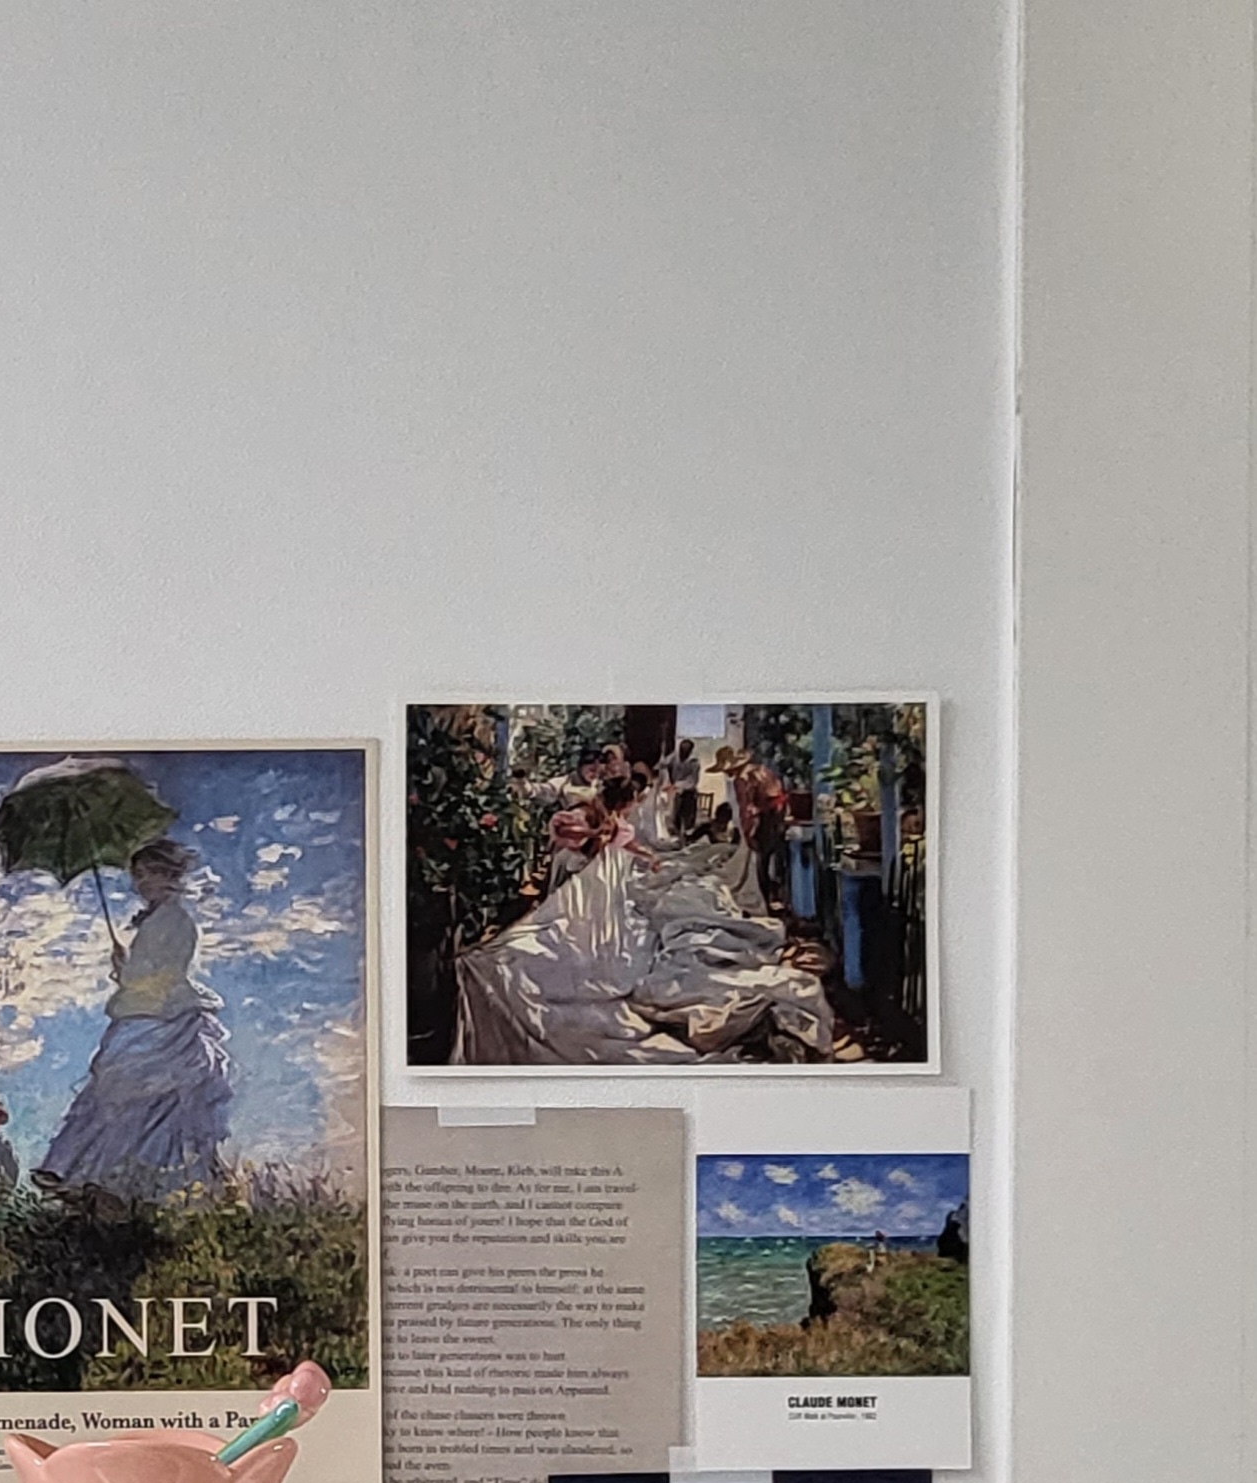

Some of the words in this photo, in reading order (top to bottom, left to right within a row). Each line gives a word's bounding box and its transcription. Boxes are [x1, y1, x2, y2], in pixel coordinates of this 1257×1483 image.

[541, 1165, 563, 1176] will
[591, 1165, 611, 1176] this
[406, 1182, 422, 1193] the
[424, 1182, 474, 1195] offspring
[477, 1182, 489, 1193] to
[516, 1182, 532, 1193] As
[534, 1182, 551, 1193] for
[452, 1199, 470, 1210] the
[505, 1199, 526, 1210] and
[516, 1216, 543, 1229] hope
[545, 1216, 566, 1227] that
[569, 1216, 587, 1227] the
[590, 1216, 613, 1227] God
[616, 1216, 629, 1227] of
[402, 1232, 426, 1245] give
[429, 1234, 450, 1245] you
[452, 1232, 470, 1243] the
[530, 1232, 551, 1243] and
[554, 1232, 583, 1243] skills
[462, 1266, 486, 1279] give
[488, 1266, 505, 1277] his
[539, 1266, 557, 1277] the
[387, 1283, 421, 1294] which
[522, 1283, 534, 1294] to
[596, 1283, 614, 1294] the
[472, 1302, 491, 1311] are
[556, 1300, 573, 1311] the
[575, 1302, 599, 1313] way
[602, 1300, 614, 1311] to
[397, 1317, 437, 1330] praised
[440, 1317, 454, 1330] by
[562, 1317, 583, 1328] The
[585, 1317, 611, 1330] only
[614, 1317, 642, 1330] thing
[397, 1333, 409, 1344] to
[411, 1333, 441, 1344] leave
[443, 1333, 460, 1344] the
[398, 1350, 410, 1361] to
[506, 1352, 527, 1361] was
[530, 1350, 542, 1361] to
[424, 1367, 444, 1378] this
[447, 1367, 472, 1378] kind
[473, 1367, 487, 1378] of
[591, 1367, 630, 1380] always
[408, 1384, 430, 1395] and
[432, 1384, 452, 1395] had
[454, 1384, 497, 1397] nothing
[499, 1384, 510, 1395] to
[539, 1386, 554, 1395] on
[788, 1396, 832, 1408] CLAUDE
[837, 1396, 878, 1408] MONET
[82, 1413, 156, 1430] Woman
[160, 1411, 204, 1429] with
[209, 1416, 221, 1428] a
[402, 1409, 419, 1420] the
[498, 1411, 524, 1420] were
[401, 1426, 412, 1437] to
[414, 1426, 444, 1437] know
[497, 1426, 523, 1437] How
[525, 1426, 563, 1439] people
[565, 1426, 596, 1437] know
[598, 1426, 620, 1437] that
[399, 1443, 424, 1454] born
[514, 1443, 535, 1454] and
[537, 1445, 559, 1454] was
[405, 1460, 422, 1471] the
